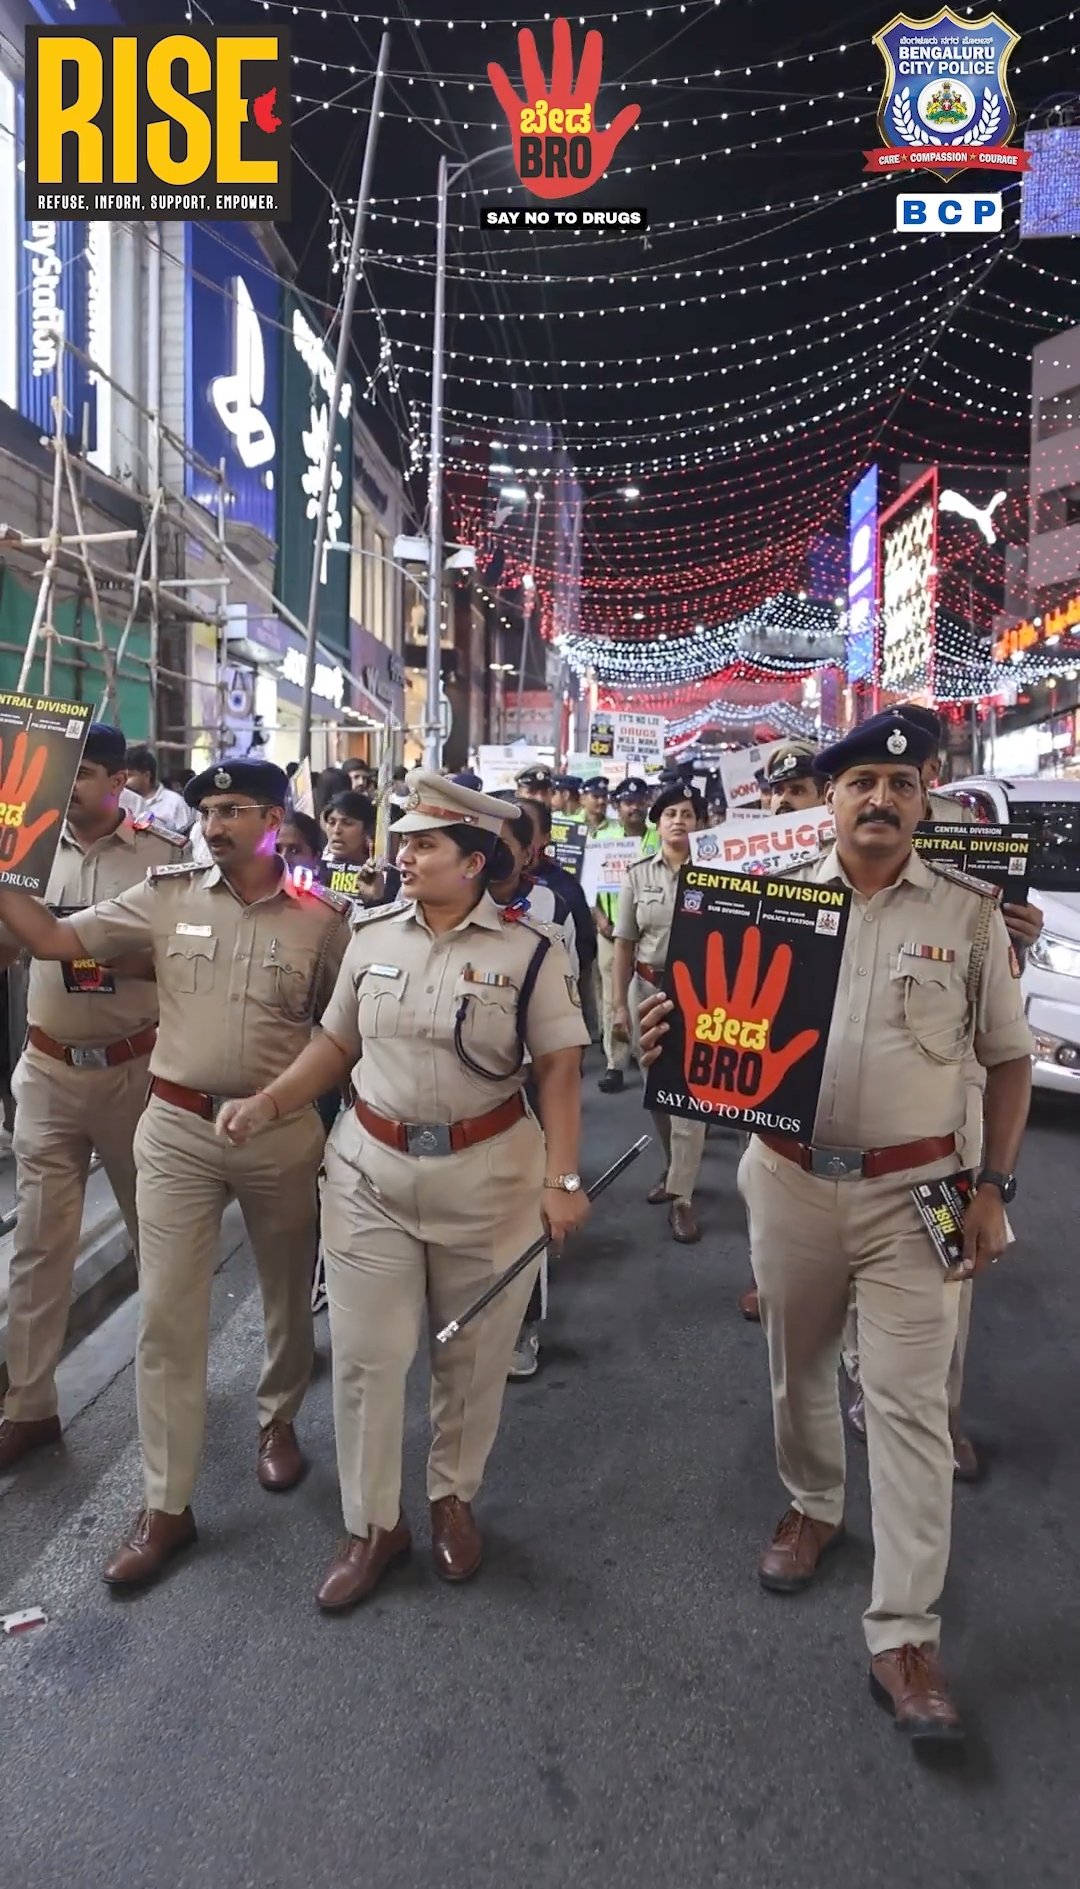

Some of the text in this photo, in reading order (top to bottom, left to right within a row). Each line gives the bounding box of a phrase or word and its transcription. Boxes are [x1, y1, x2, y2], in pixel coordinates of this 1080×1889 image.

[36, 699, 89, 717] DIVISION
[620, 726, 657, 738] DRUGS
[934, 825, 1002, 836] CENTRAL DIVISION
[970, 840, 1030, 853] DIVISION
[1, 871, 40, 889] DRUGS
[686, 871, 845, 907] CENTRAL DIVISION
[721, 907, 750, 917] DIVISION
[762, 913, 816, 927] POLICE STATION
[695, 1007, 769, 1051] ಬೇಡ
[688, 1042, 763, 1096] BRO
[656, 1090, 802, 1133] SAY NO TO DRUGS
